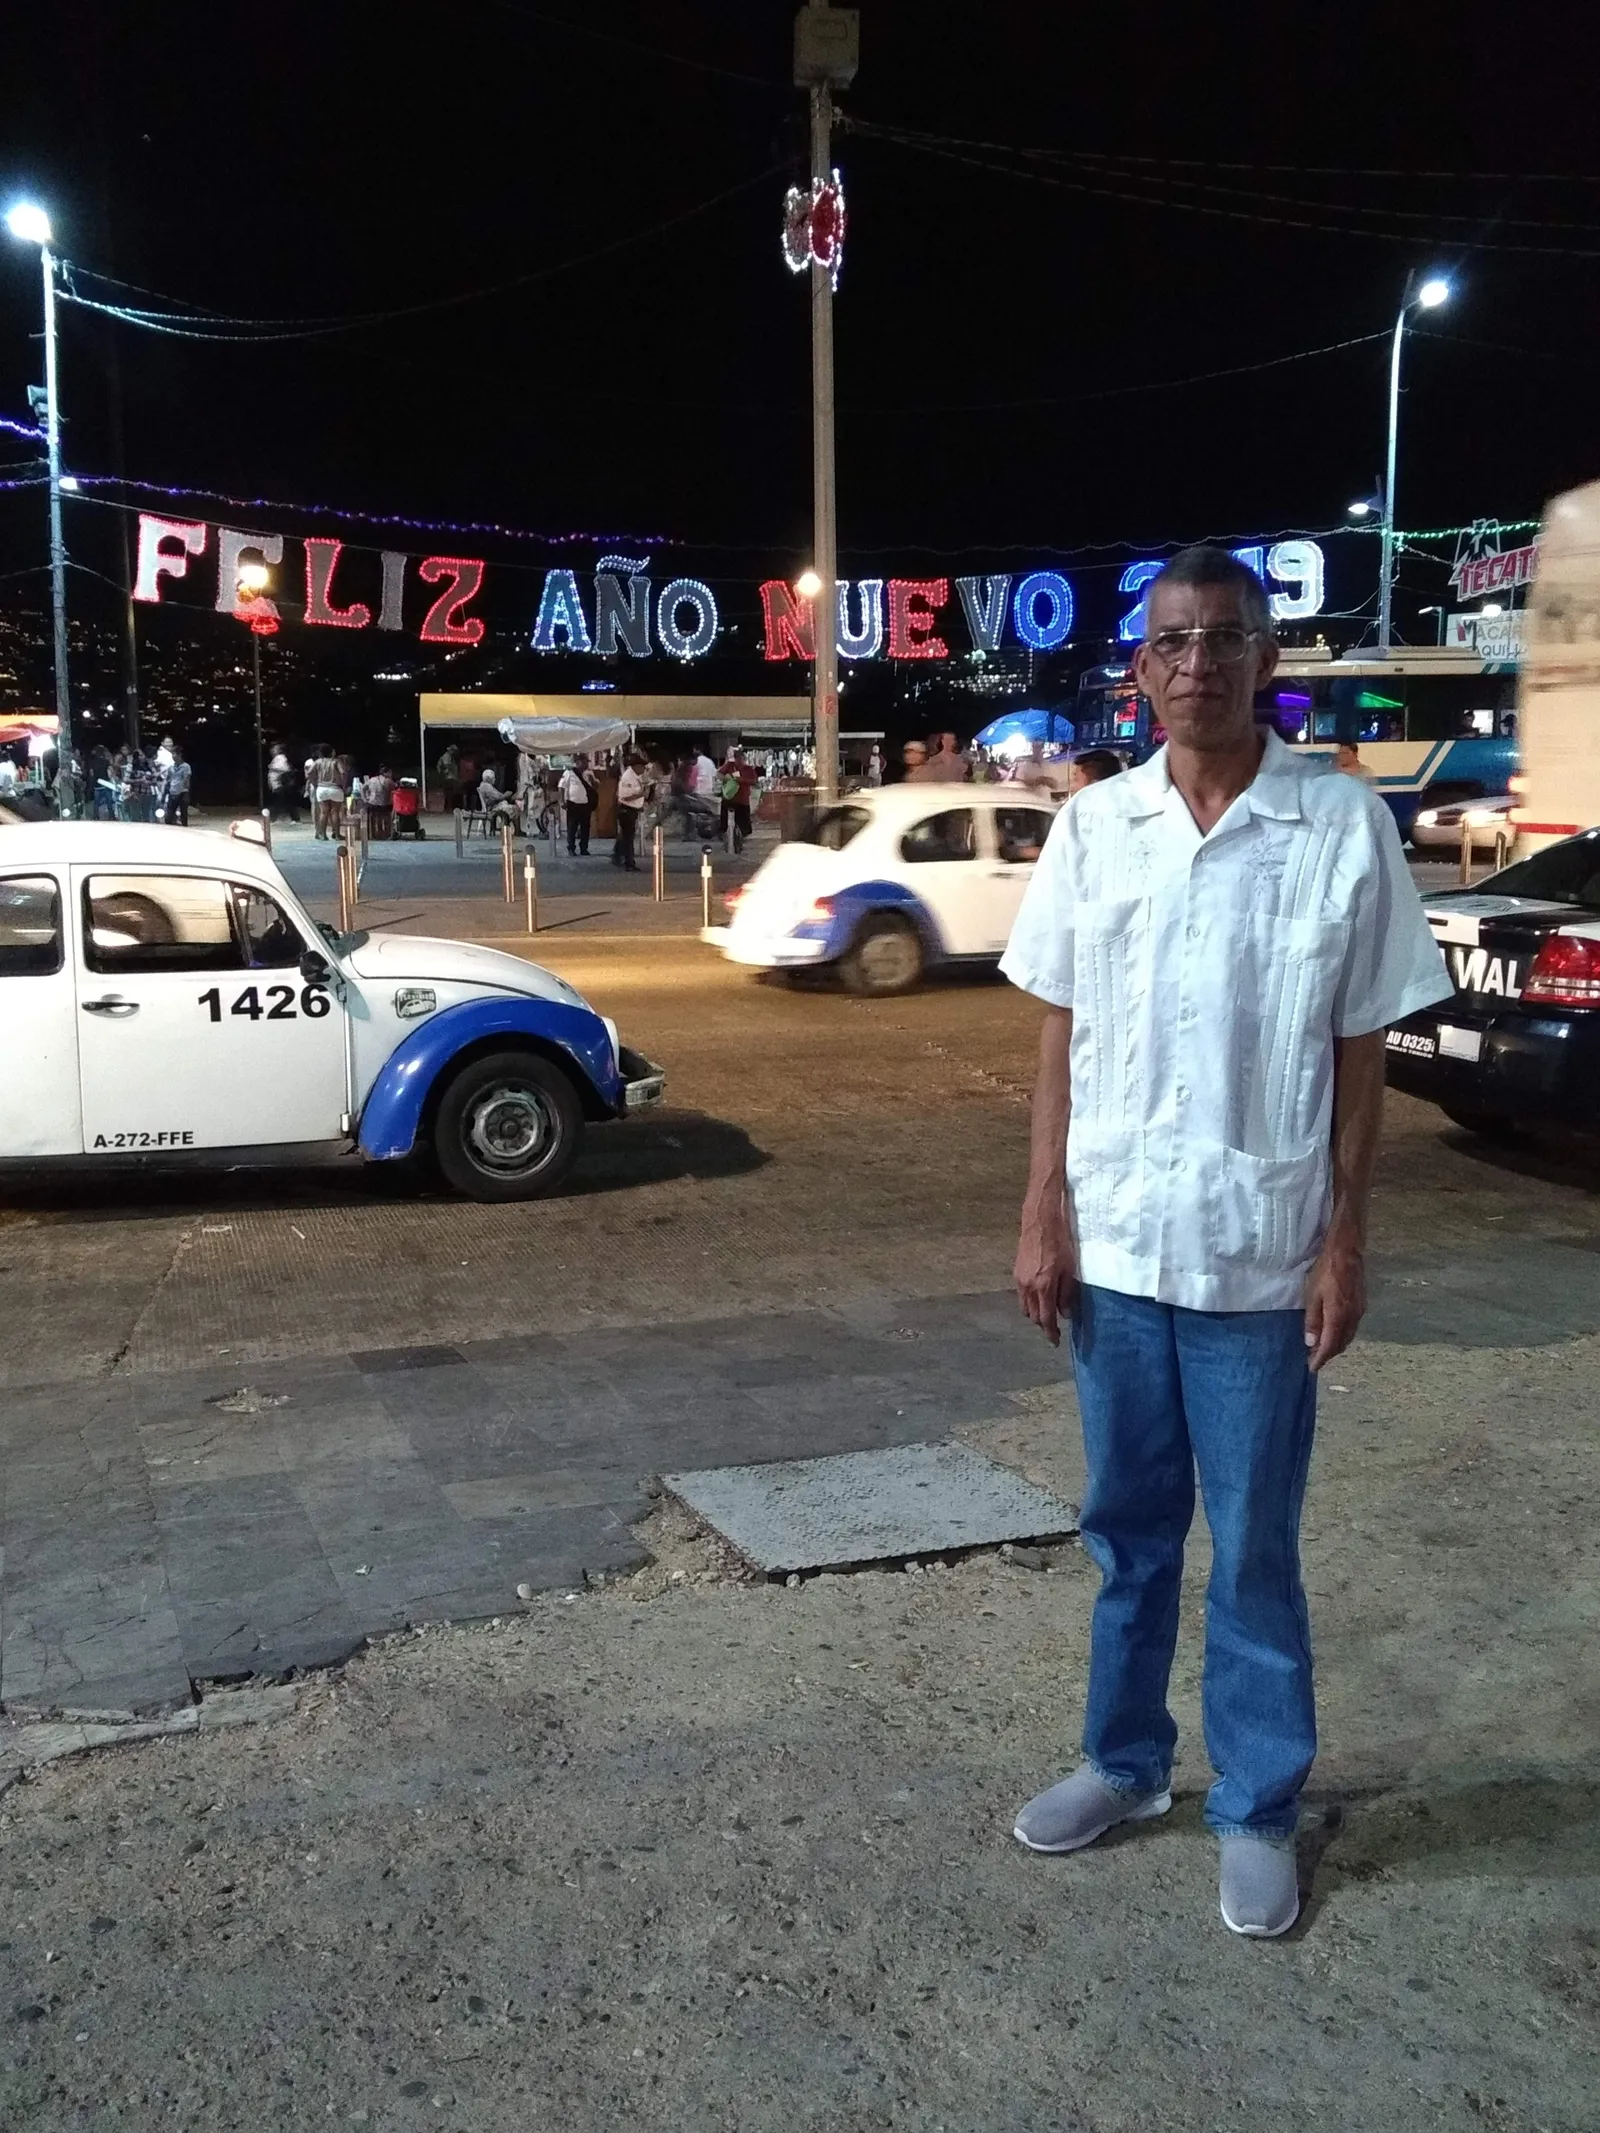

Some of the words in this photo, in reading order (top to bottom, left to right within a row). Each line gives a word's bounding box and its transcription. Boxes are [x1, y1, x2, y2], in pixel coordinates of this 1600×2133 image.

[132, 514, 485, 643] FELIZ
[531, 555, 718, 658] AÑO
[759, 571, 1074, 660] NUEVO
[1453, 946, 1522, 998] VIAL
[198, 984, 331, 1022] 1426
[1386, 1030, 1403, 1046] AU
[93, 1131, 194, 1149] A-272-FFE
